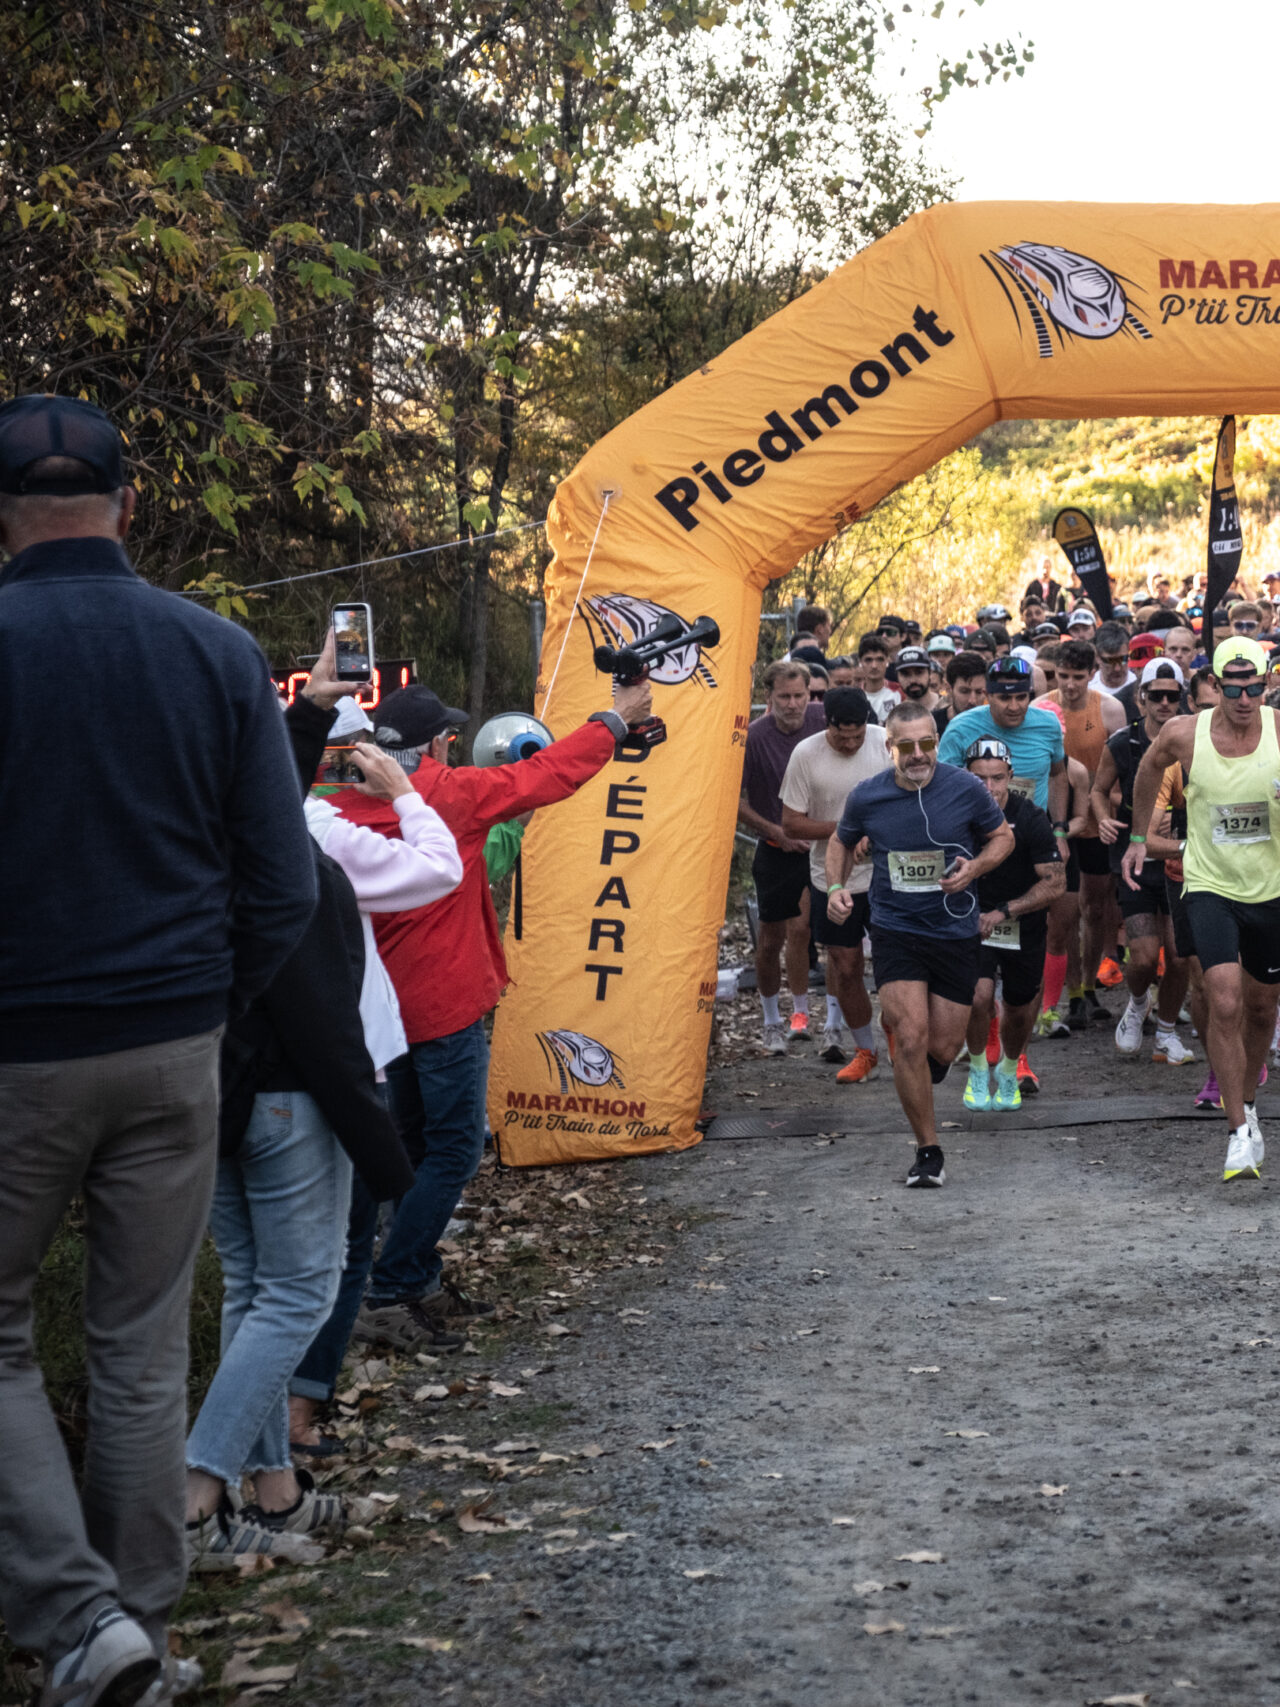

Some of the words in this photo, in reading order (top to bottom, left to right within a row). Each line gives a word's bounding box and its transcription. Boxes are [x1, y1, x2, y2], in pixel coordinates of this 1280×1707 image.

[655, 304, 956, 532] Piedmont
[1220, 816, 1261, 829] 1374
[898, 865, 936, 877] 1307
[507, 1090, 646, 1118] MARATHON
[545, 1114, 596, 1135] Train
[598, 1120, 622, 1136] du
[625, 1121, 671, 1140] Nord
